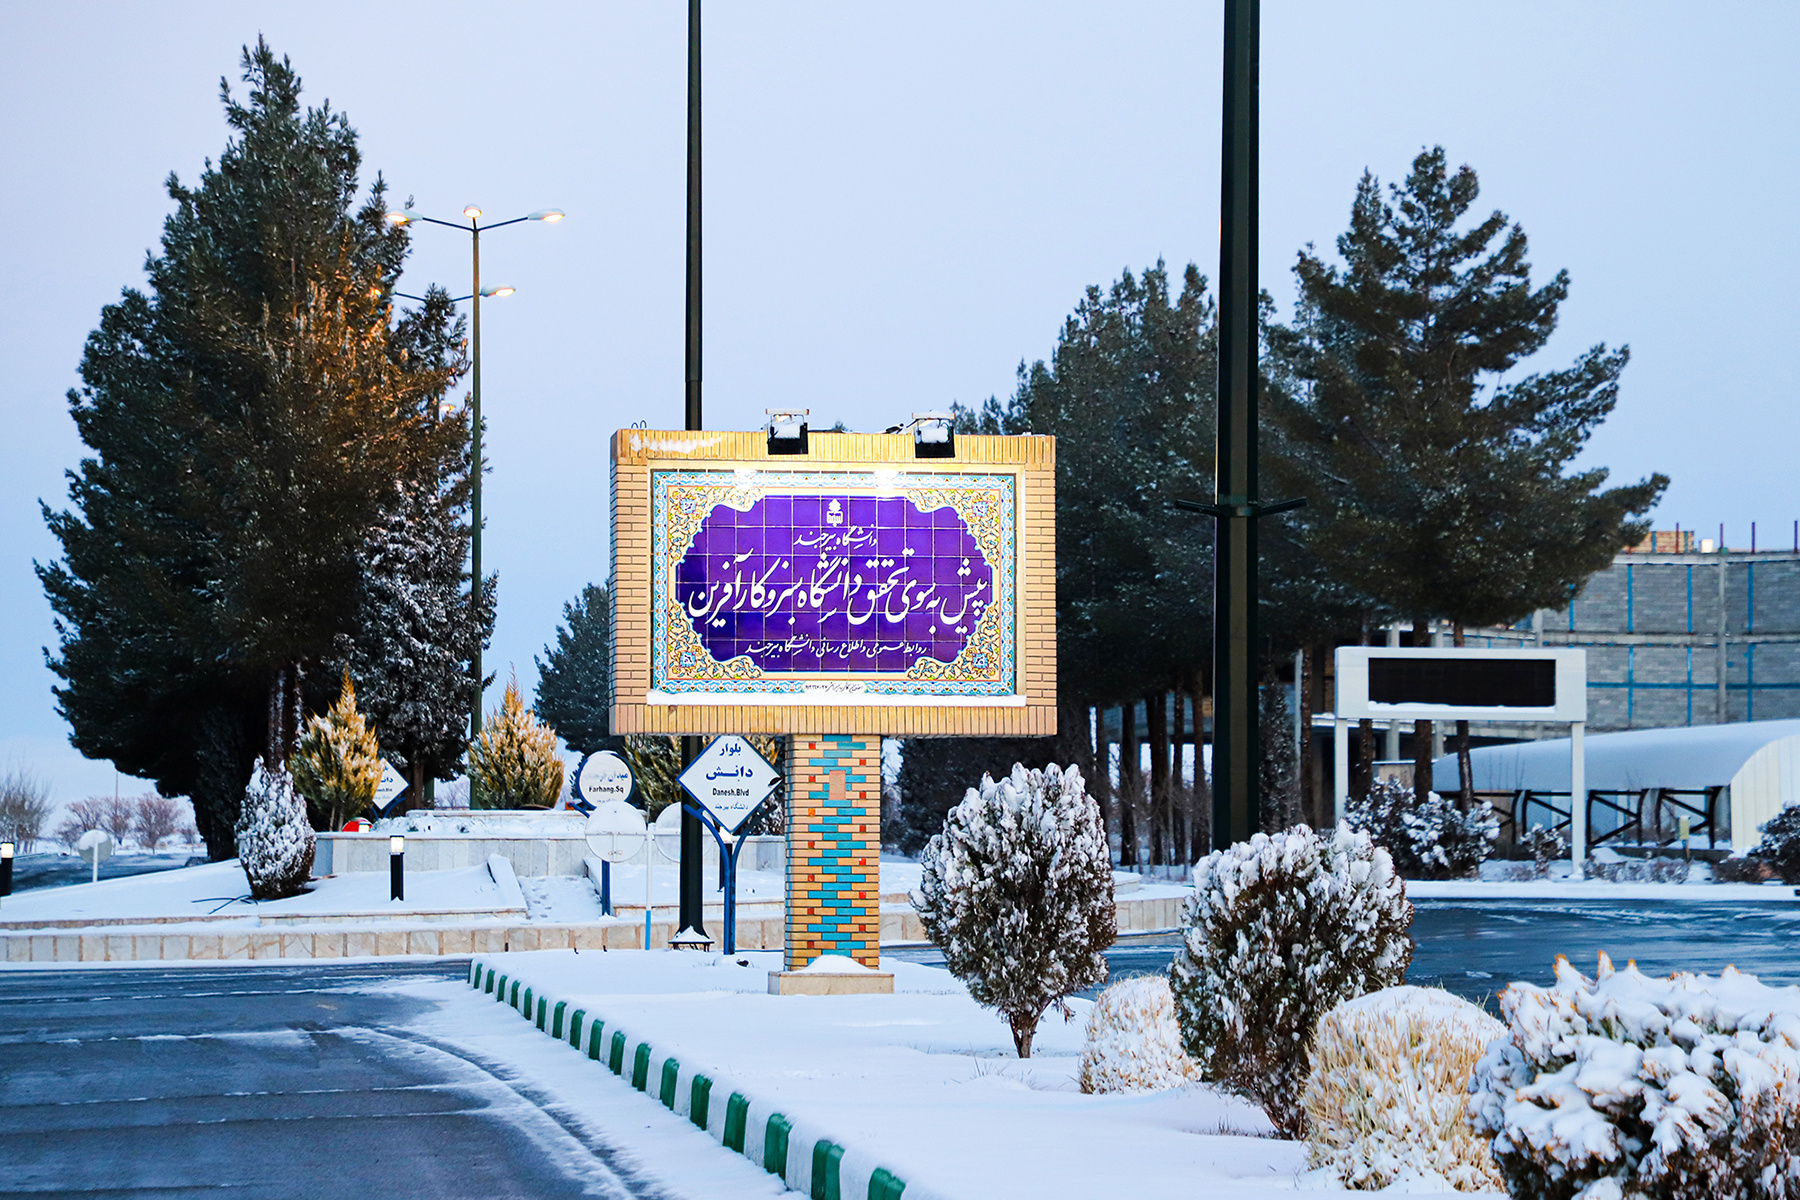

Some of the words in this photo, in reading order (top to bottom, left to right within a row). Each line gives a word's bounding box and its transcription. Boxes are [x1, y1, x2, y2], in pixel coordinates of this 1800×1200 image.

[793, 531, 836, 551] بیرجند
[836, 524, 878, 549] دانشگاه
[797, 551, 863, 623] دانشگاه
[846, 547, 916, 626] تحقق
[940, 558, 988, 635] پیش
[884, 579, 937, 623] سوی
[924, 595, 942, 635] به
[778, 633, 815, 656] دانشگاه
[865, 641, 904, 659] عمومی
[903, 642, 927, 657] روابط
[705, 764, 754, 781] دانش
